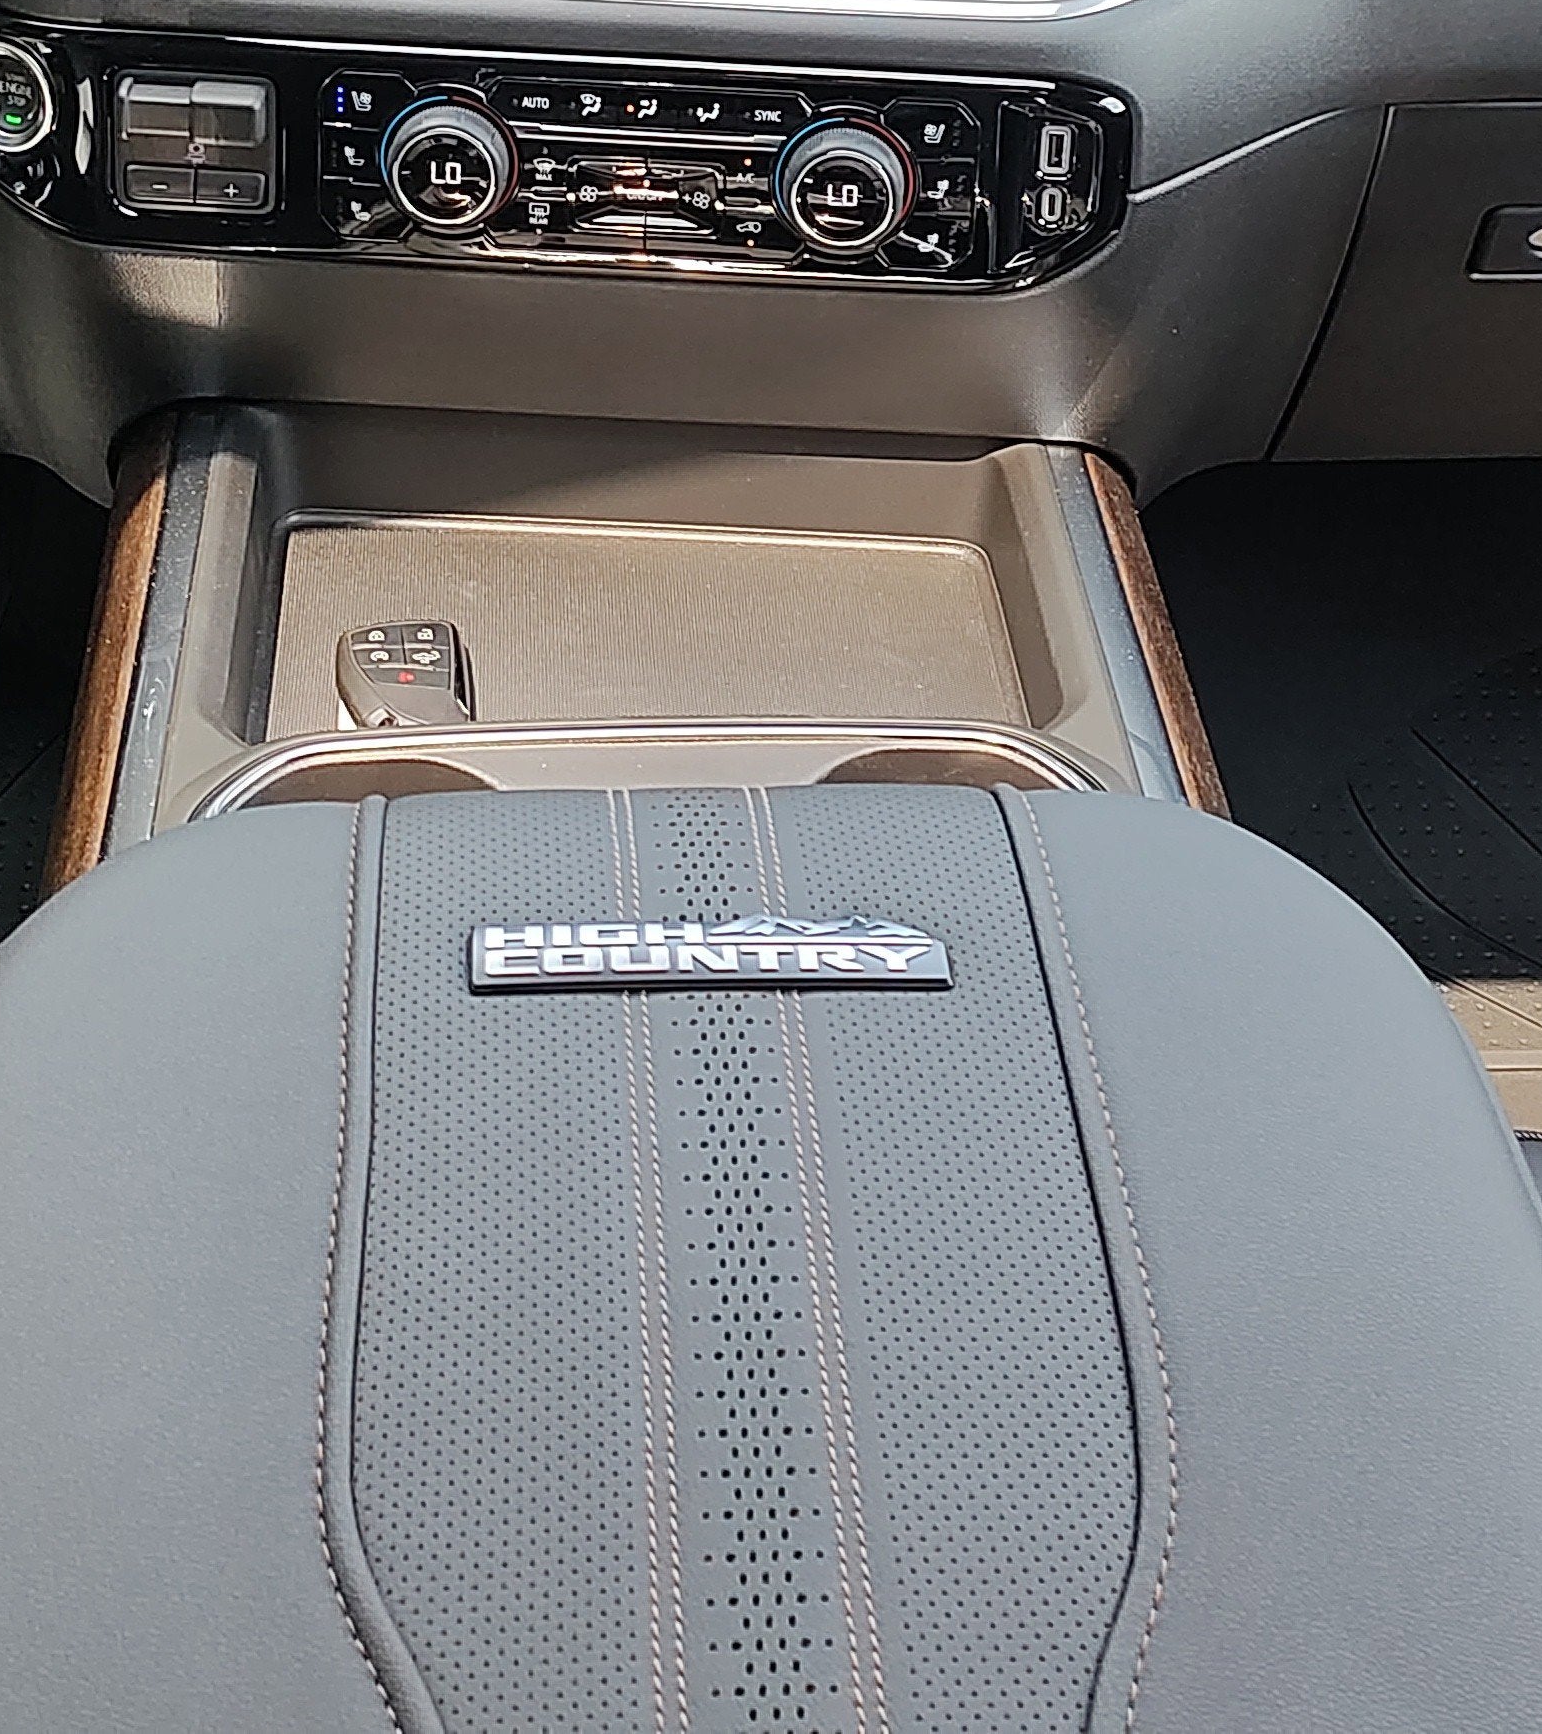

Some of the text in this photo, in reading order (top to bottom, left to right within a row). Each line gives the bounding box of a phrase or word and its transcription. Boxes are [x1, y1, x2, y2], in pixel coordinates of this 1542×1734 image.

[521, 97, 550, 109] AUTO
[754, 109, 781, 123] SYNC
[484, 923, 704, 949] HIGH
[484, 944, 932, 976] COUNTRY
